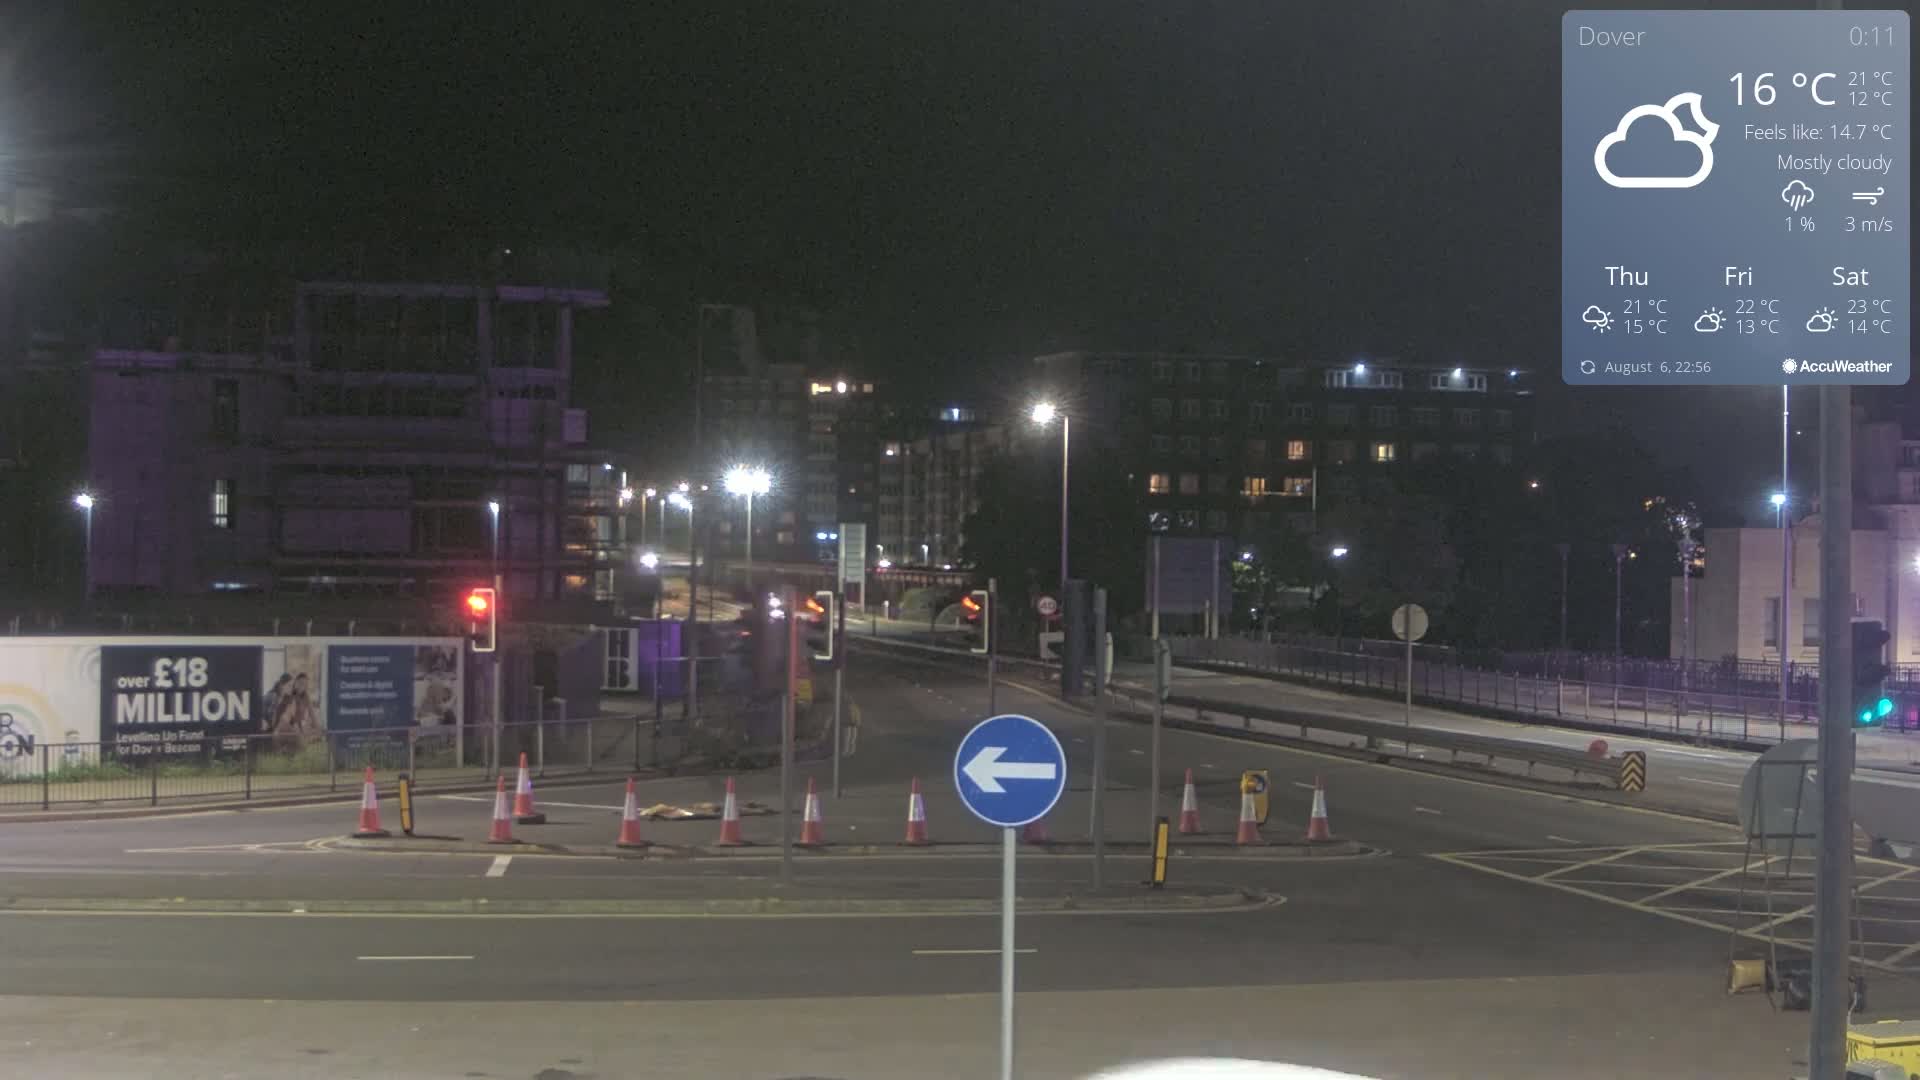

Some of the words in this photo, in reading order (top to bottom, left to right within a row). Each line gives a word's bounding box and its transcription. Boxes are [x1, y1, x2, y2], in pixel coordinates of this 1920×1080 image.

[117, 676, 150, 688] over
[154, 657, 208, 688] £18
[116, 691, 250, 724] MILLION
